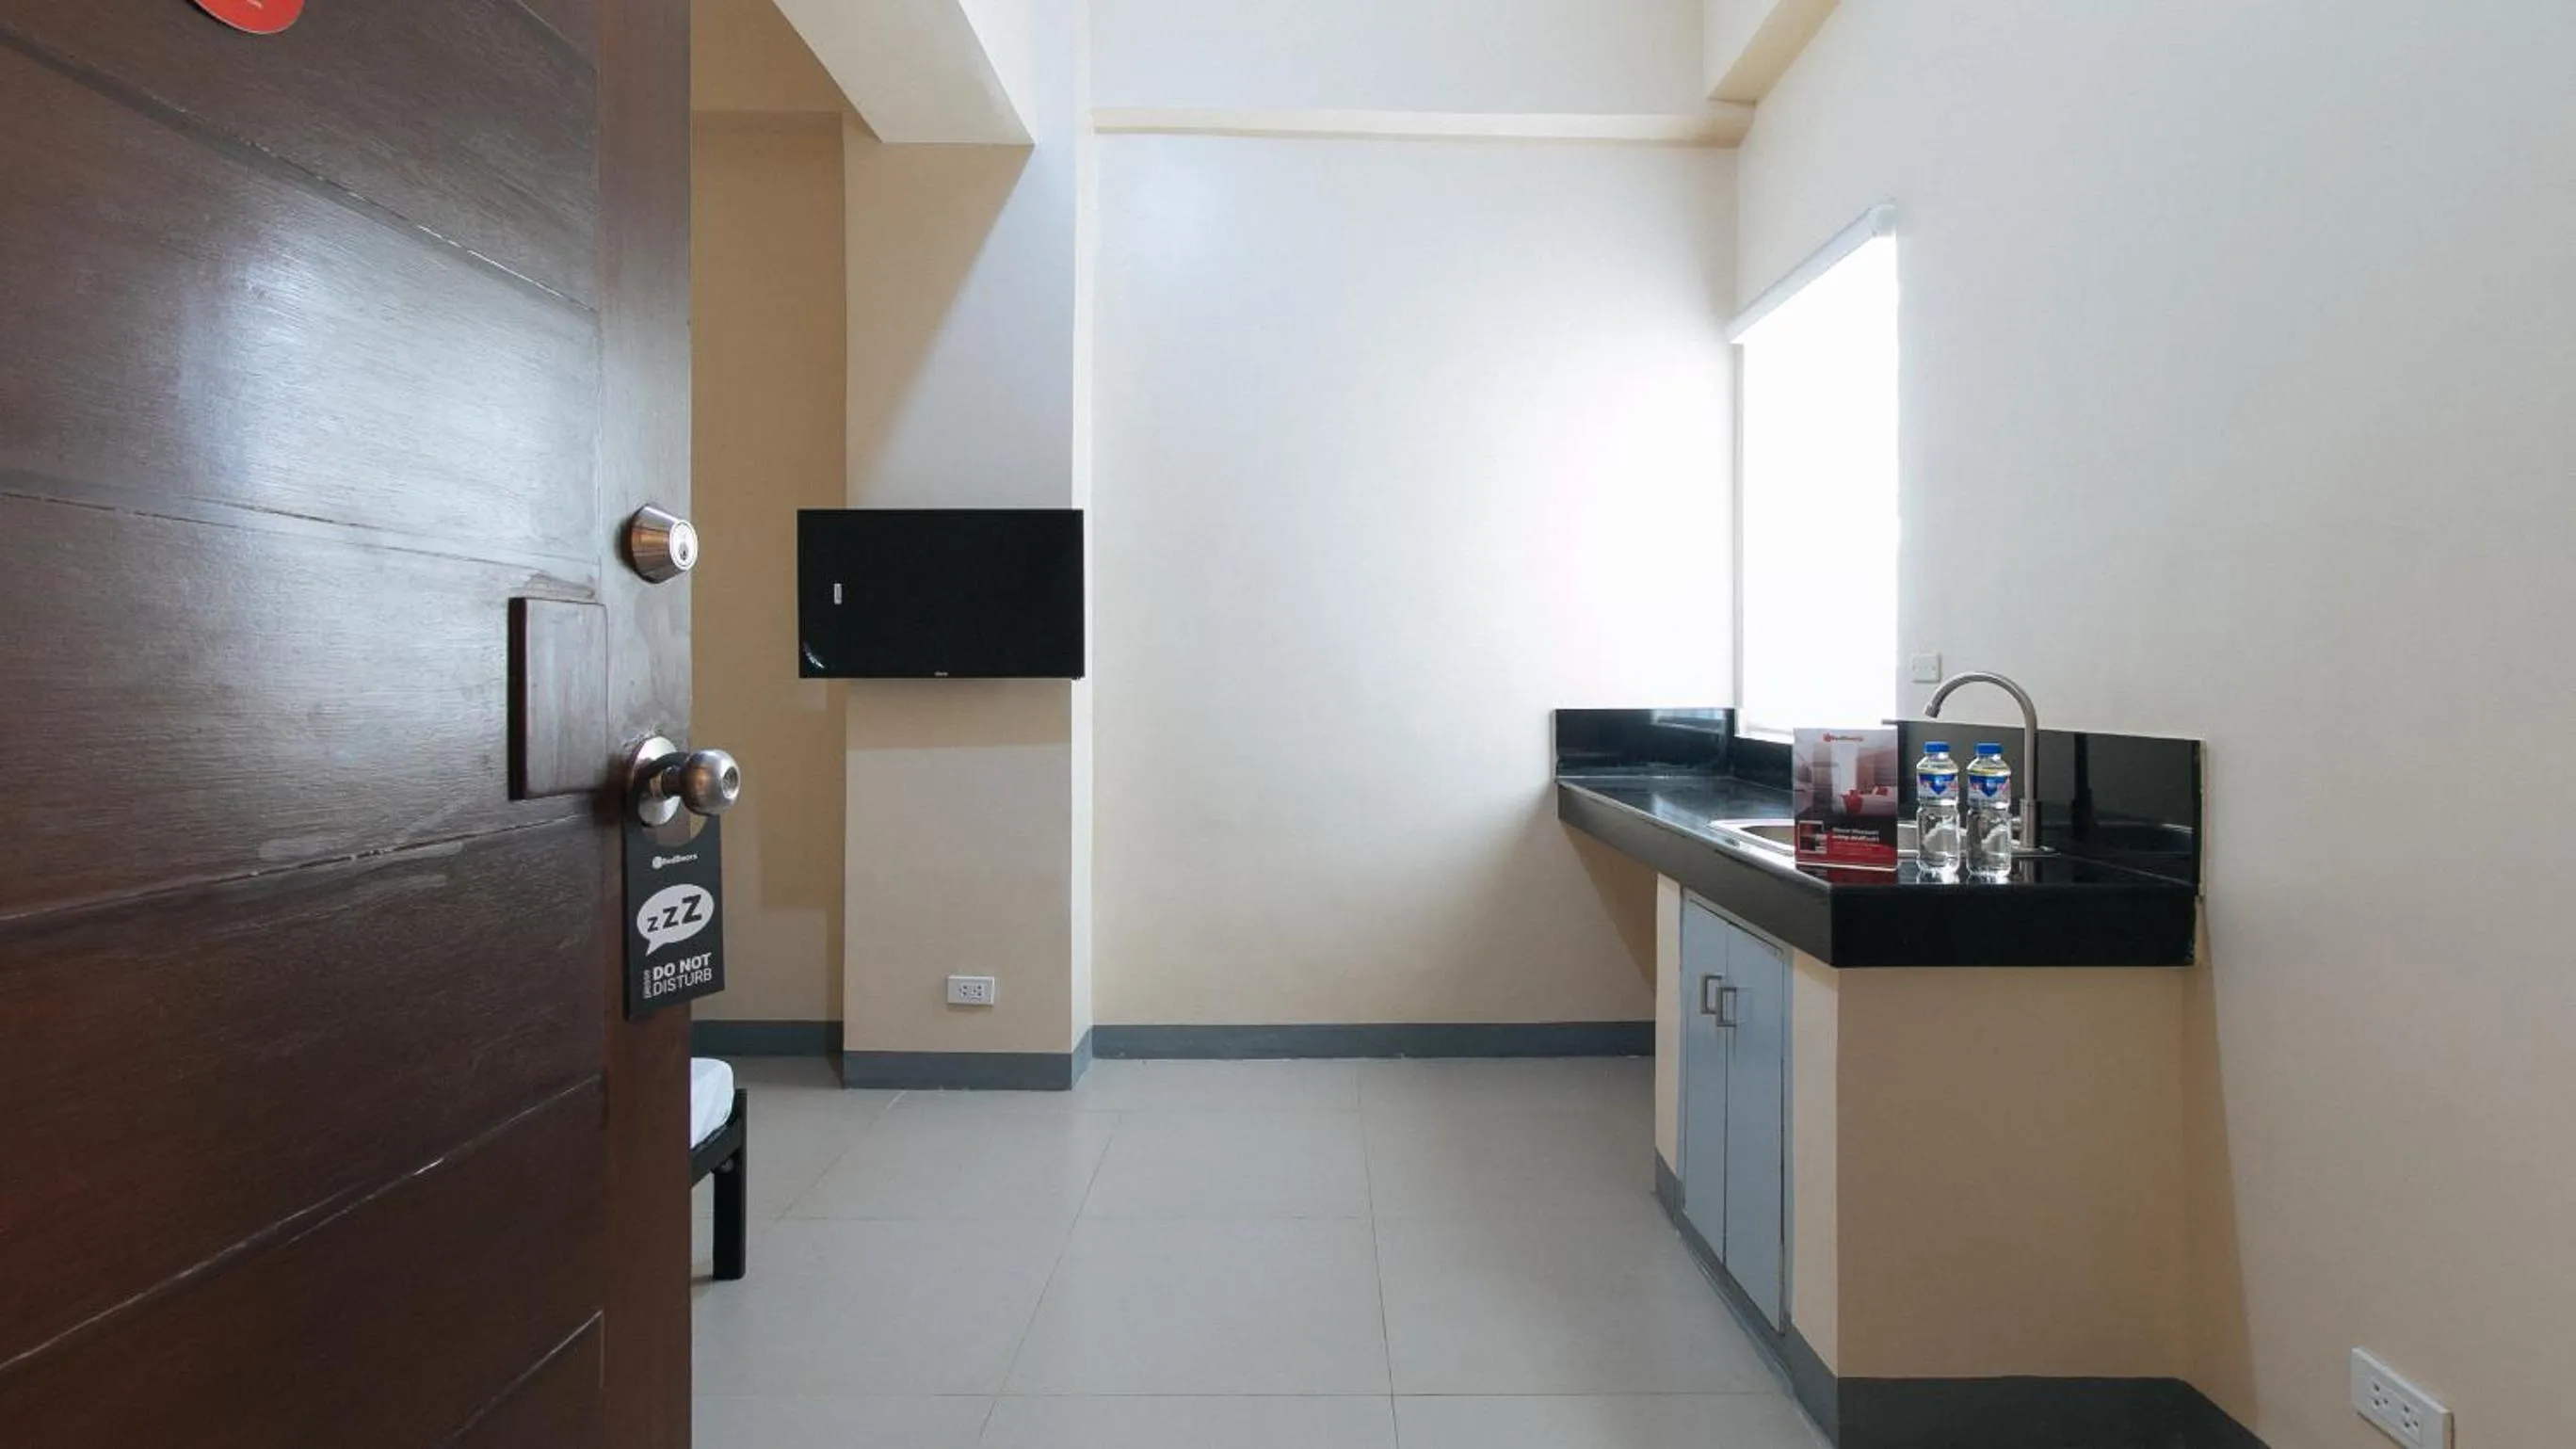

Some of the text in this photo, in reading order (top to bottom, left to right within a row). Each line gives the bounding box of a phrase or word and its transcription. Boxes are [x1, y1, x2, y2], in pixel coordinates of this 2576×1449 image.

[652, 952, 713, 980] DO NOT
[652, 968, 713, 996] DISTURB
